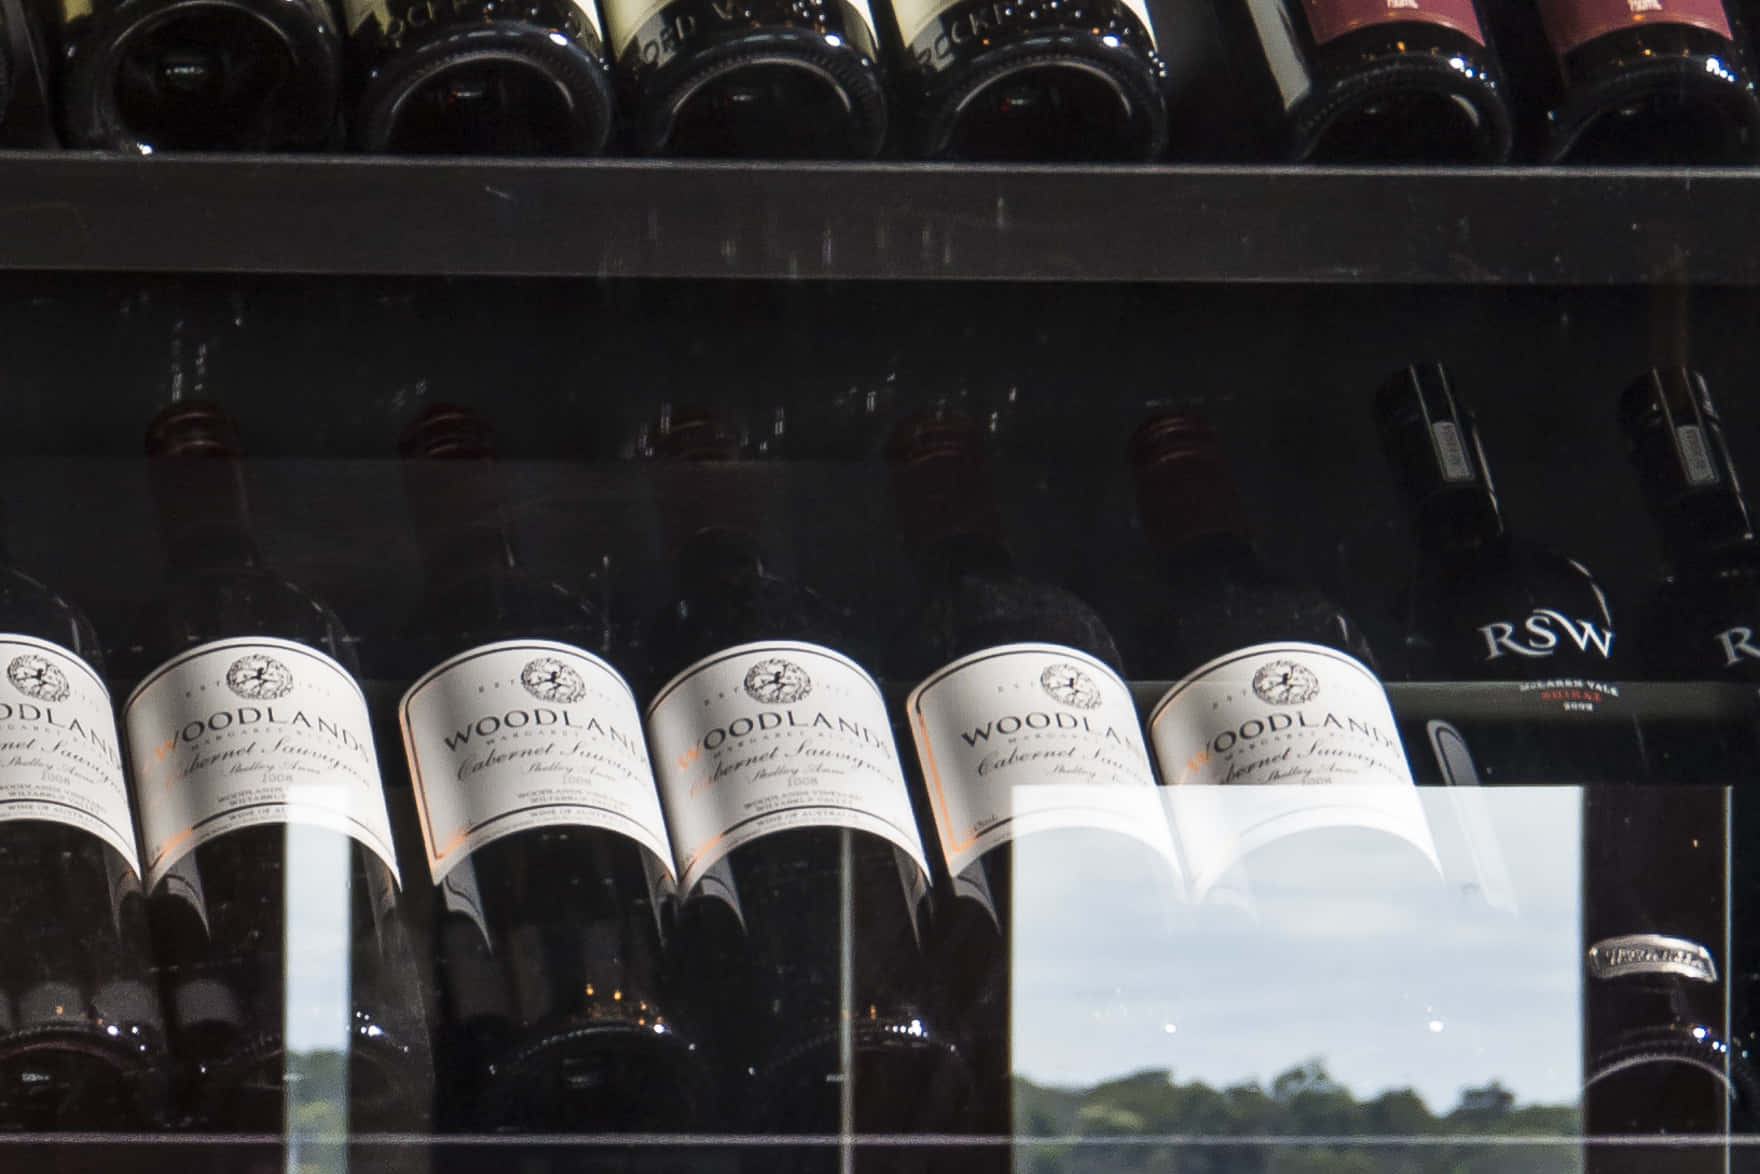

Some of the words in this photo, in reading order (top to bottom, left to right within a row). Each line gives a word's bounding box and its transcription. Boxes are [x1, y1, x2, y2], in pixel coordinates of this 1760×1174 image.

[1477, 608, 1614, 660] RSW
[457, 742, 555, 782] Cabernet
[977, 746, 1077, 777] Cabernet
